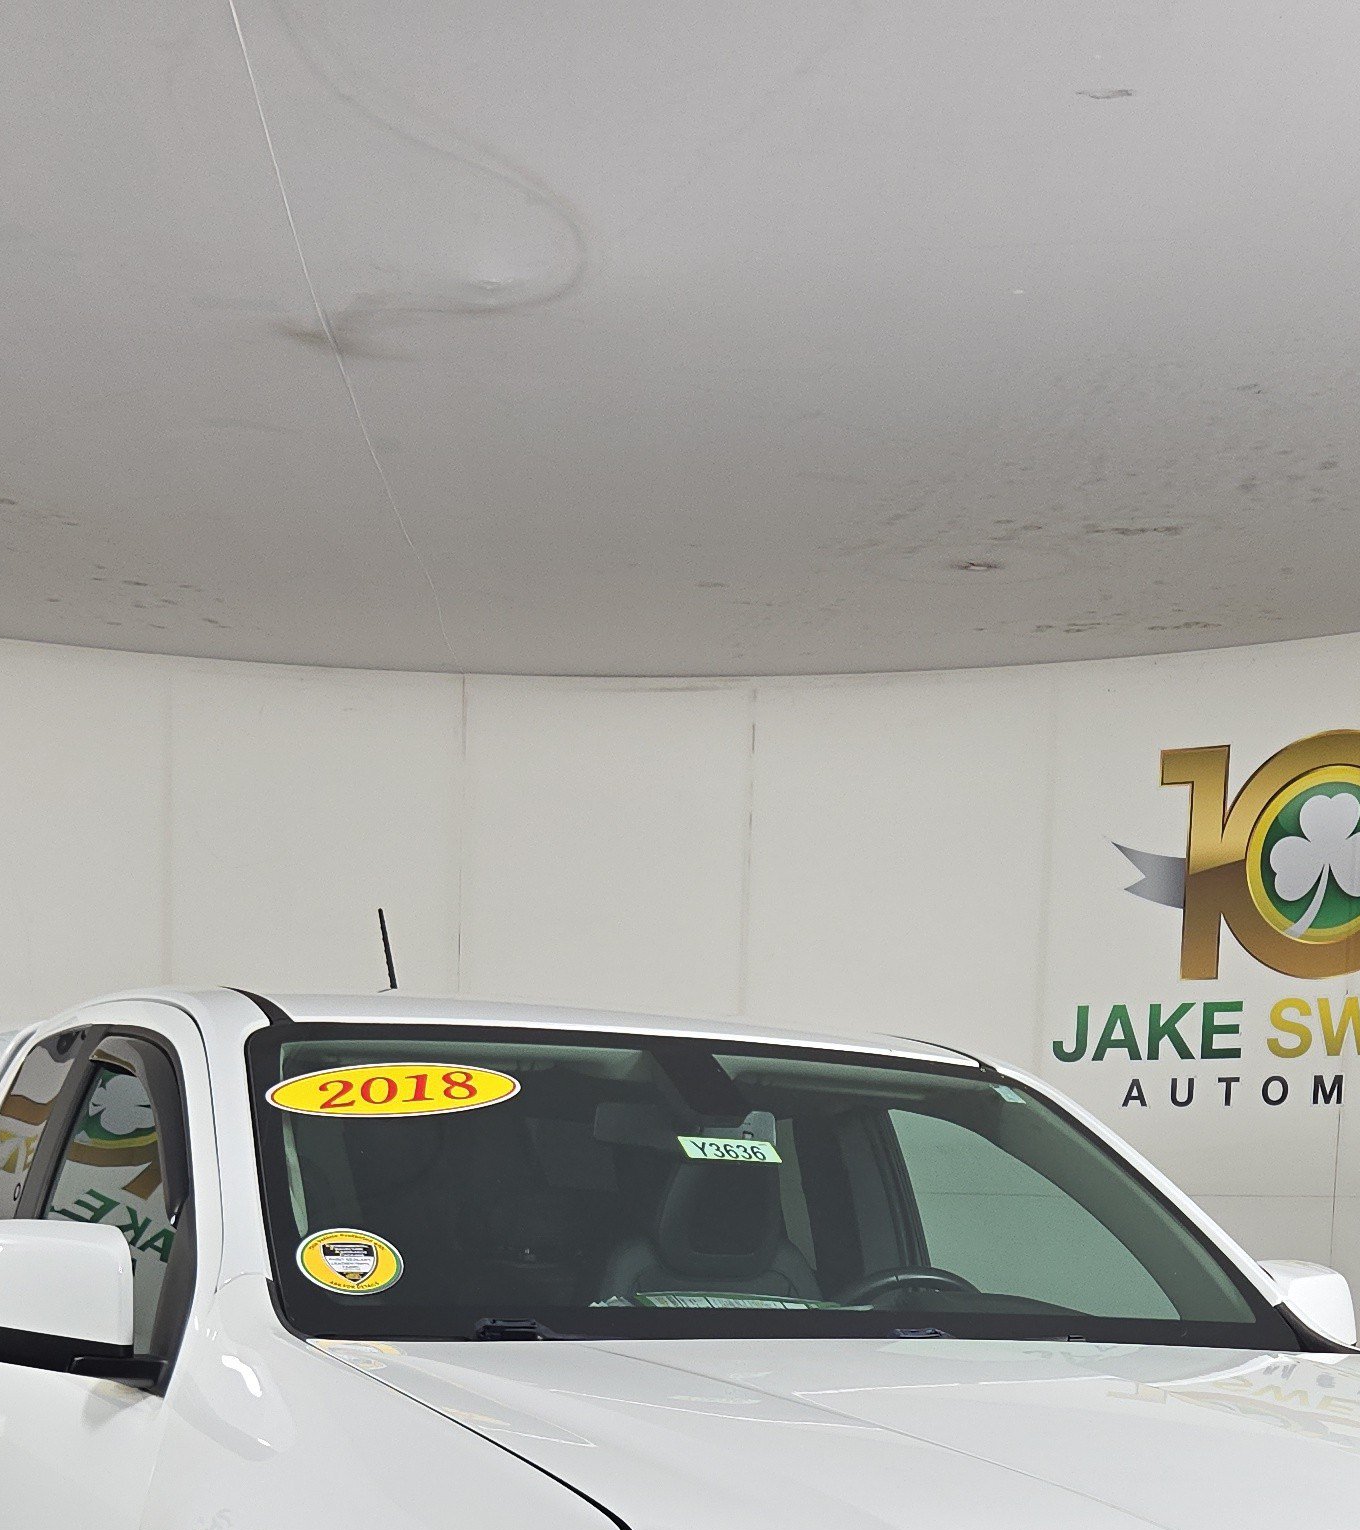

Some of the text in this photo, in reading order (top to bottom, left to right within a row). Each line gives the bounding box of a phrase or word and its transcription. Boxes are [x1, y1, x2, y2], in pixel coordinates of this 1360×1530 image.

[1051, 1000, 1244, 1063] JAKE
[319, 1071, 478, 1111] 2018
[690, 1140, 767, 1161] Y3636
